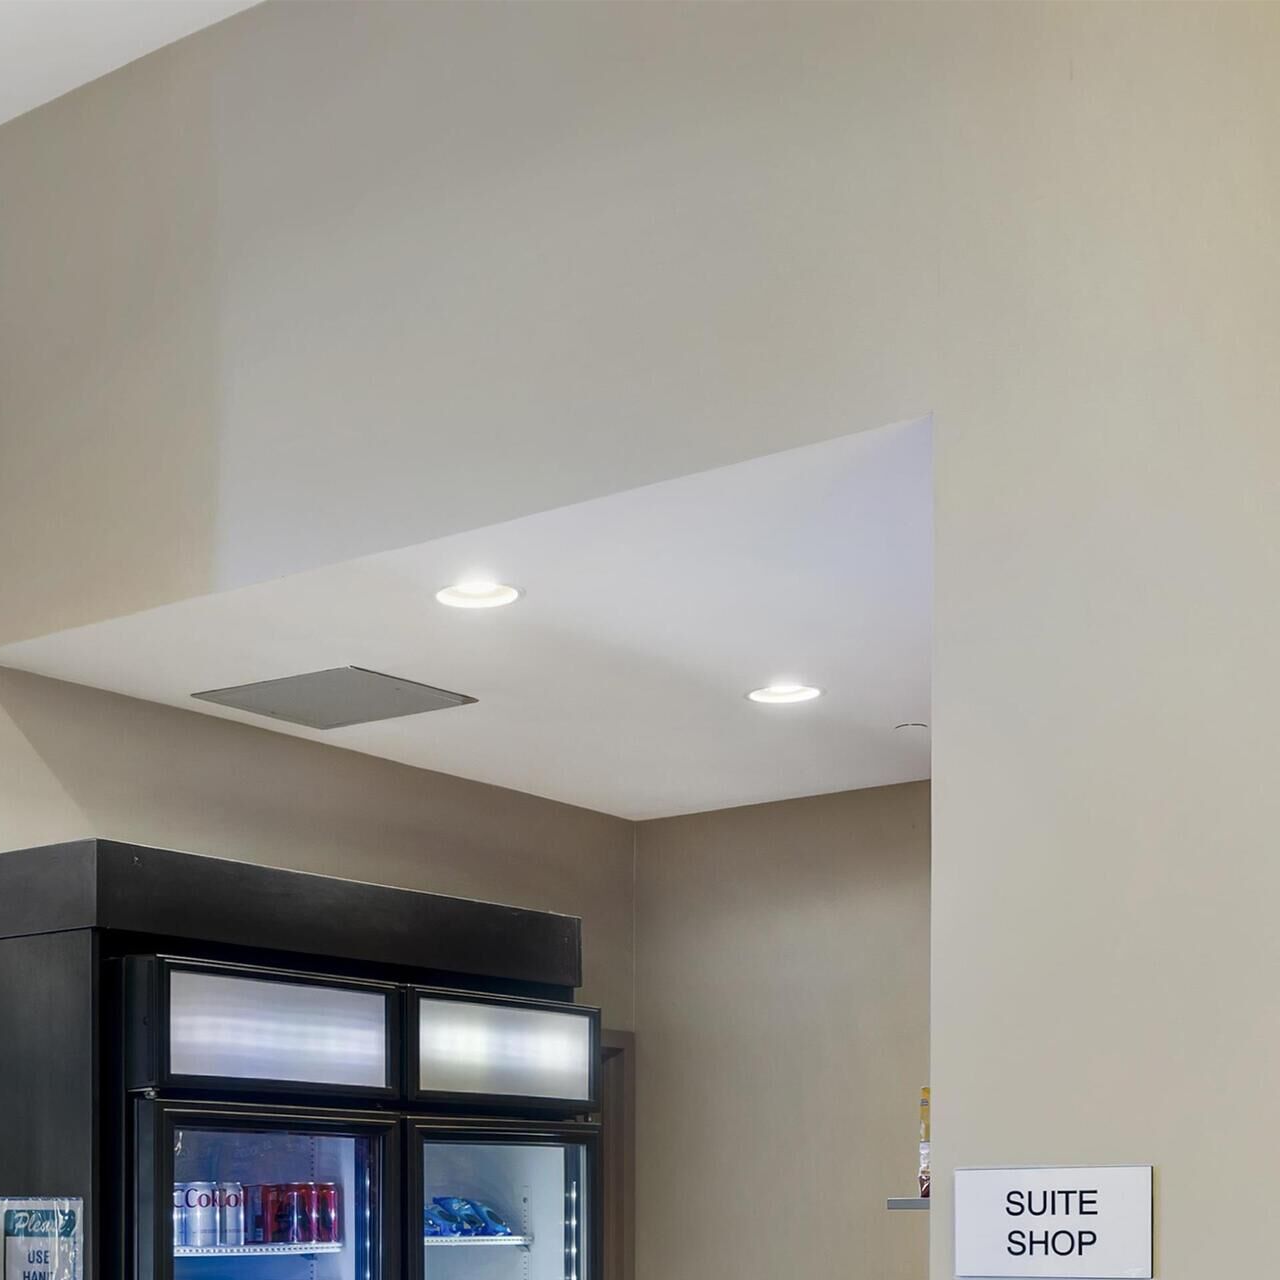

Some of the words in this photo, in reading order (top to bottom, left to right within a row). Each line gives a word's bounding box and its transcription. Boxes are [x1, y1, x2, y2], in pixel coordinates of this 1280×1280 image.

[1005, 1190, 1098, 1216] SUITE
[1006, 1230, 1097, 1256] SHOP
[28, 1250, 49, 1264] USE
